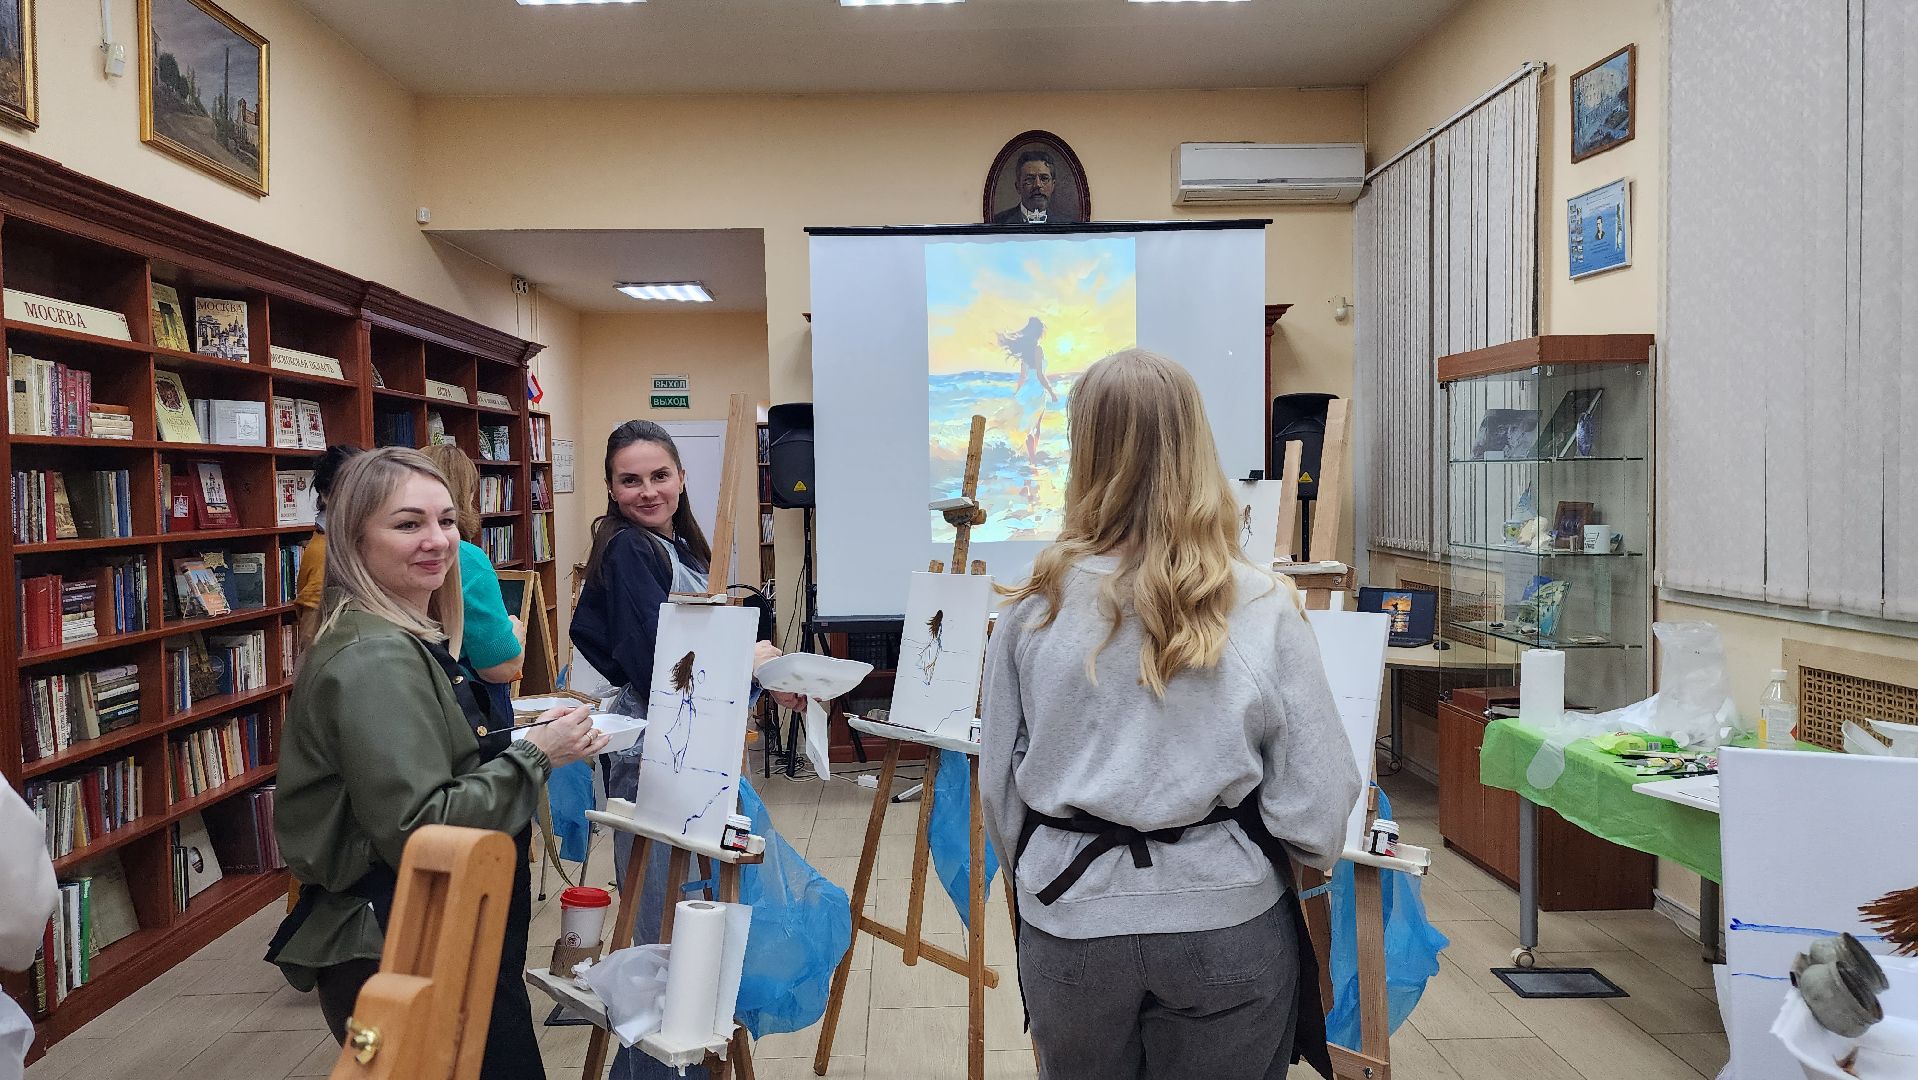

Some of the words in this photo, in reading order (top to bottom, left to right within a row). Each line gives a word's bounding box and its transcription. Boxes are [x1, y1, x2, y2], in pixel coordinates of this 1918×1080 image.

[199, 302, 244, 313] МОСКВА
[24, 301, 87, 328] МОСКВА
[655, 380, 686, 388] ВЫХОД
[653, 398, 687, 406] ВЫХОД
